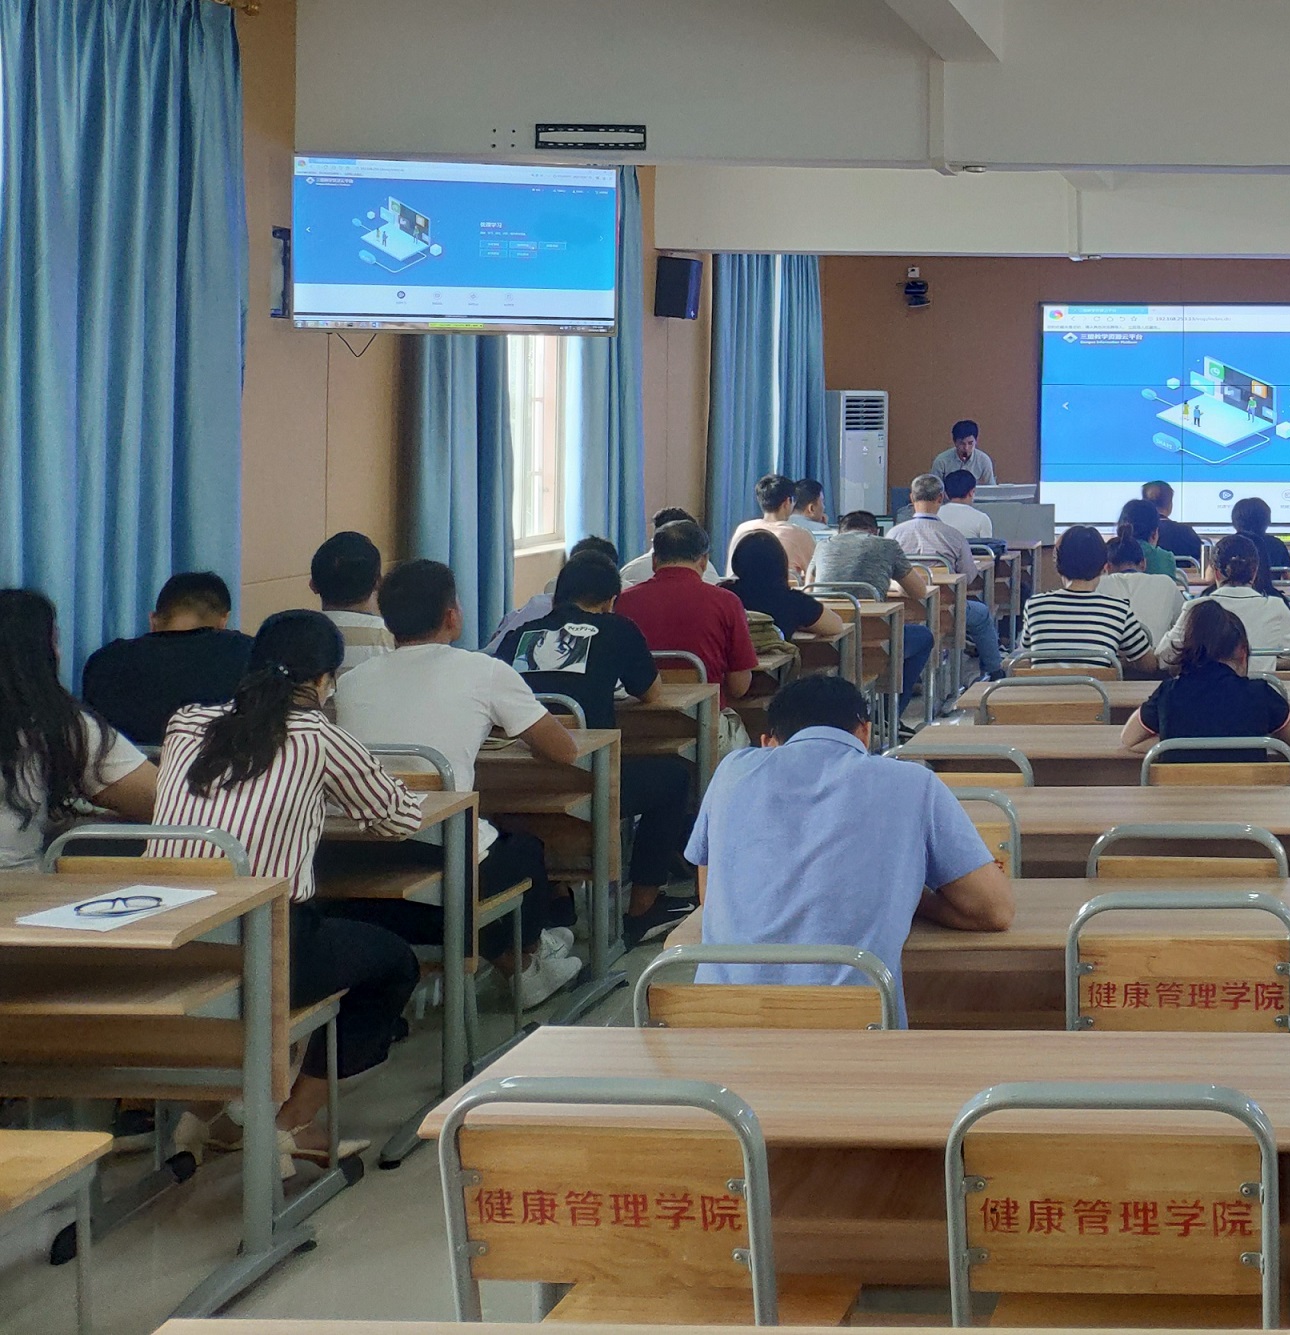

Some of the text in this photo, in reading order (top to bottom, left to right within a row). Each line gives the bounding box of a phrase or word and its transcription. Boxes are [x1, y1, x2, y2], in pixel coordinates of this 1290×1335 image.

[1087, 981, 1285, 1010] 健康管理学院
[475, 1188, 743, 1232] 健康管理学院
[980, 1197, 1254, 1237] 健康管理学院
